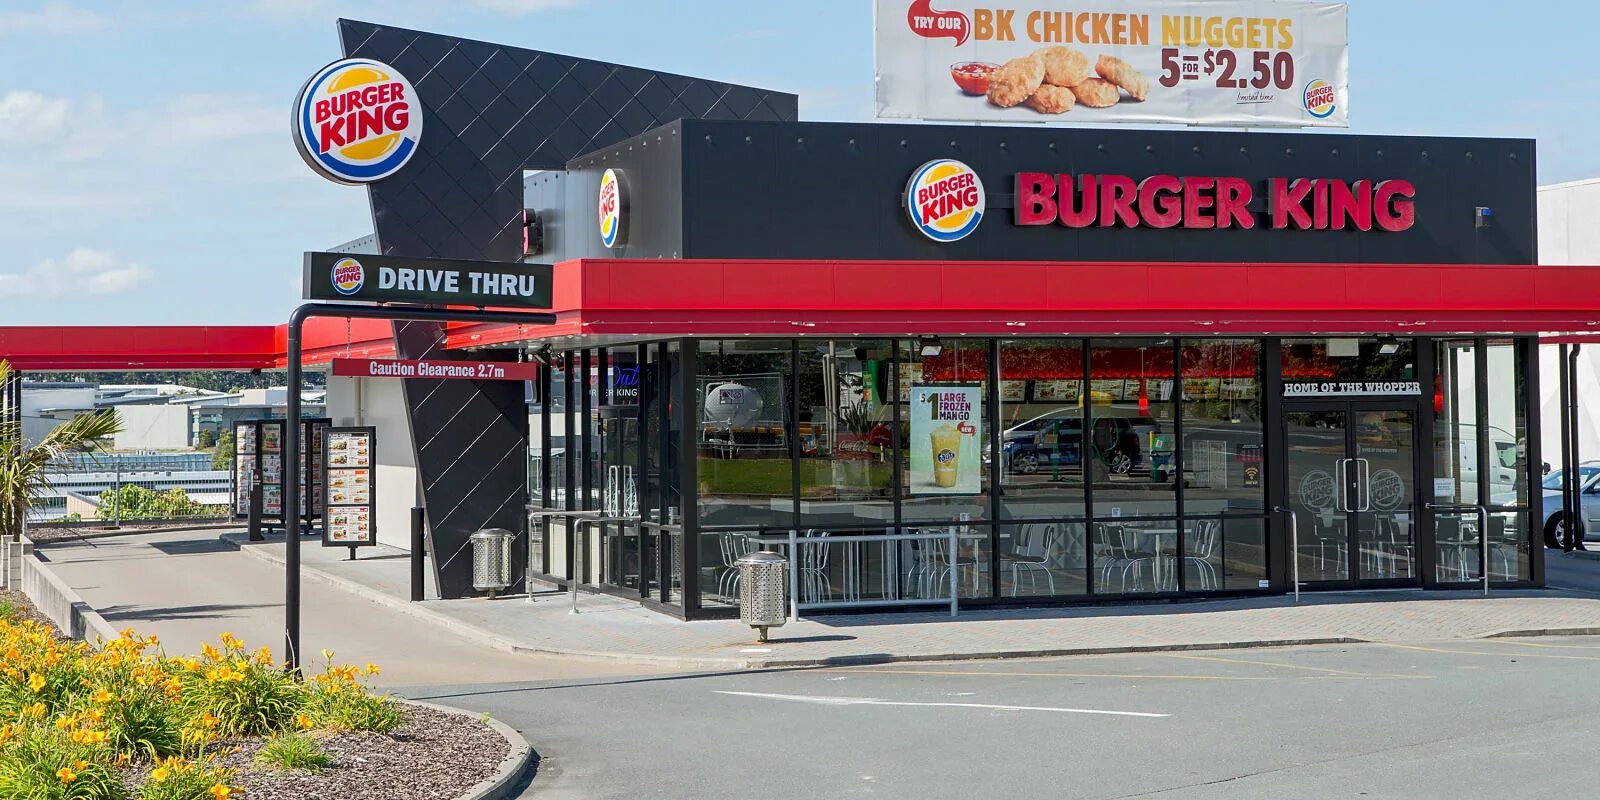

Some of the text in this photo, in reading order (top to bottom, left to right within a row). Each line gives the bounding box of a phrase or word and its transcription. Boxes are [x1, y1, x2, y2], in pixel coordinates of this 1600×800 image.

[914, 16, 962, 31] TRY OUR
[974, 9, 1293, 49] BK CHICKEN NUGGETS
[1159, 48, 1294, 90] 5 FOR $2.50
[1237, 91, 1274, 101] limited time
[1306, 85, 1333, 99] BURGER
[315, 82, 405, 124] BURGER
[1307, 93, 1334, 110] KING
[320, 101, 409, 153] KING
[918, 173, 975, 205] BURGER
[922, 186, 978, 225] KING
[1015, 172, 1416, 232] BURGER KING
[335, 266, 361, 276] BURGER
[335, 273, 361, 284] KING
[378, 266, 535, 297] DRIVE THRU
[369, 361, 505, 378] Caution Clearance 2.7m
[616, 388, 638, 397] KING
[1284, 382, 1421, 393] HOME OF THE WHOPPER
[939, 393, 966, 402] LARGE
[939, 402, 971, 411] FROZEN
[939, 411, 970, 420] MANGO
[1303, 477, 1332, 493] BURGER
[1371, 476, 1399, 492] BURGER
[1305, 486, 1333, 501] KING
